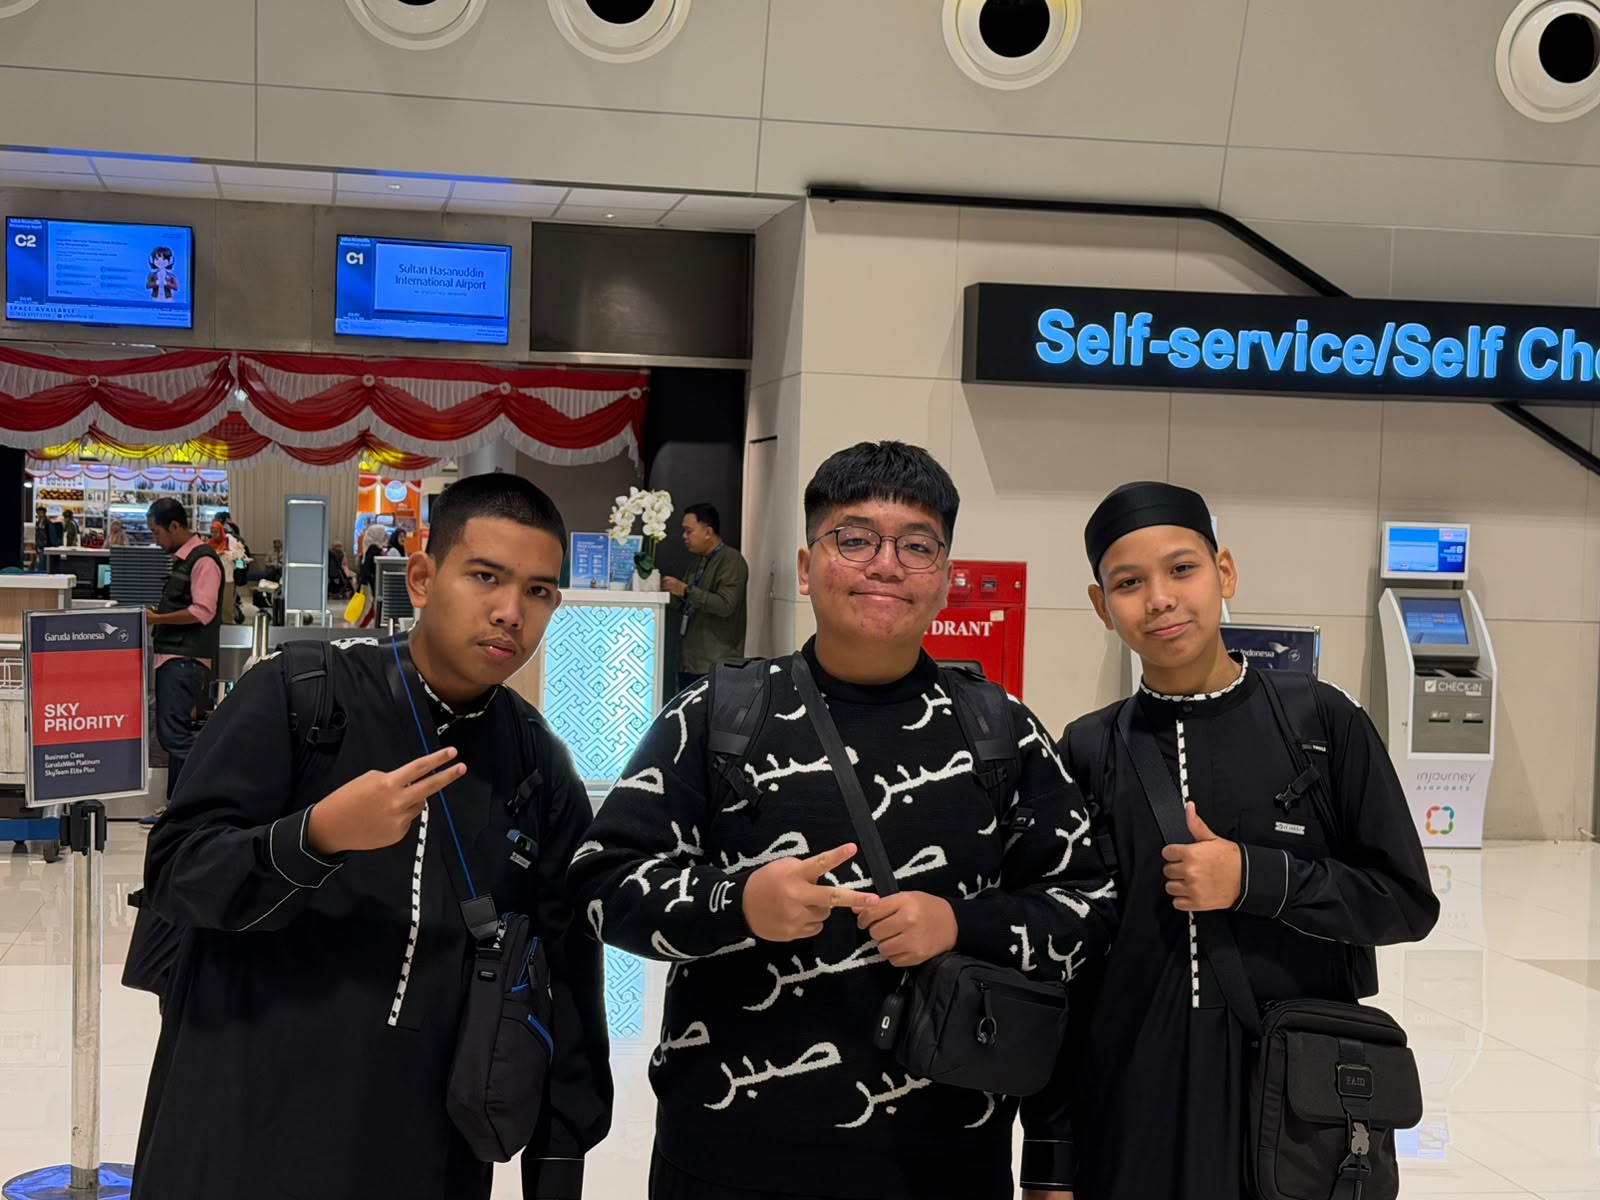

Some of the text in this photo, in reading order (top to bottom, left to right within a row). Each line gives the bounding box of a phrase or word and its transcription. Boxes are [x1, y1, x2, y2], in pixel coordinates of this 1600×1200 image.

[15, 234, 37, 248] C2
[346, 251, 364, 265] C1
[399, 263, 484, 279] Sultan Hasanuddin
[395, 275, 486, 291] International Airport
[1035, 308, 1507, 379] Self-service/Self
[924, 619, 994, 637] DRANT
[44, 631, 105, 642] Garuda Indonesia
[44, 702, 80, 718] SKY
[44, 714, 125, 733] PRIORITY
[44, 751, 85, 761] Business Class
[76, 759, 101, 767] Platinum
[703, 1042, 842, 1110] صبر
